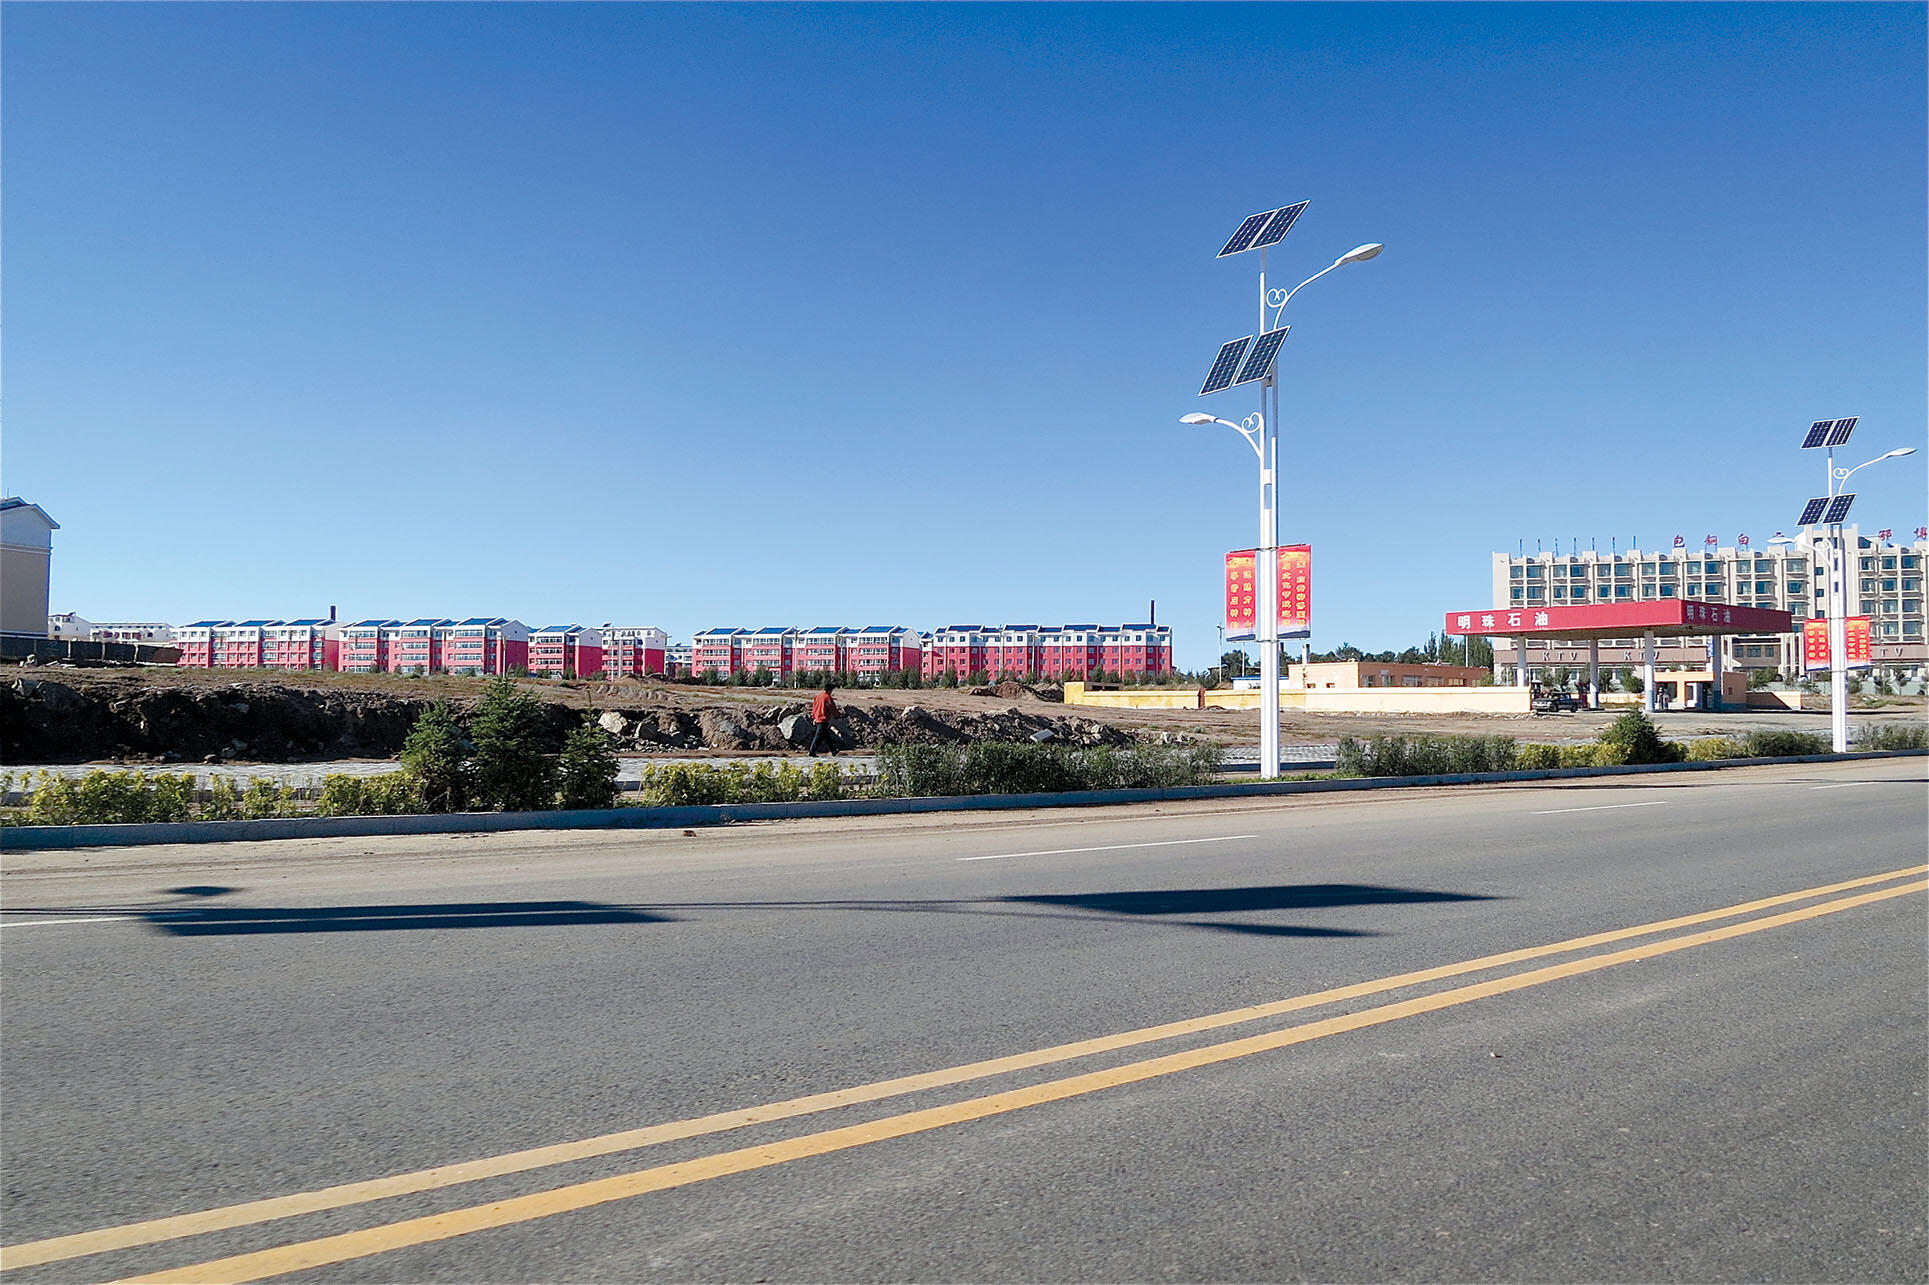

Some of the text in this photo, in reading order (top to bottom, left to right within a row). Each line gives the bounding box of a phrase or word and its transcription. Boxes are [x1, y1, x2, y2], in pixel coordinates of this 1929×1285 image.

[1457, 611, 1549, 629] 明珠石油
[1686, 605, 1731, 623] 明珠石油
[1543, 651, 1578, 661] KTV
